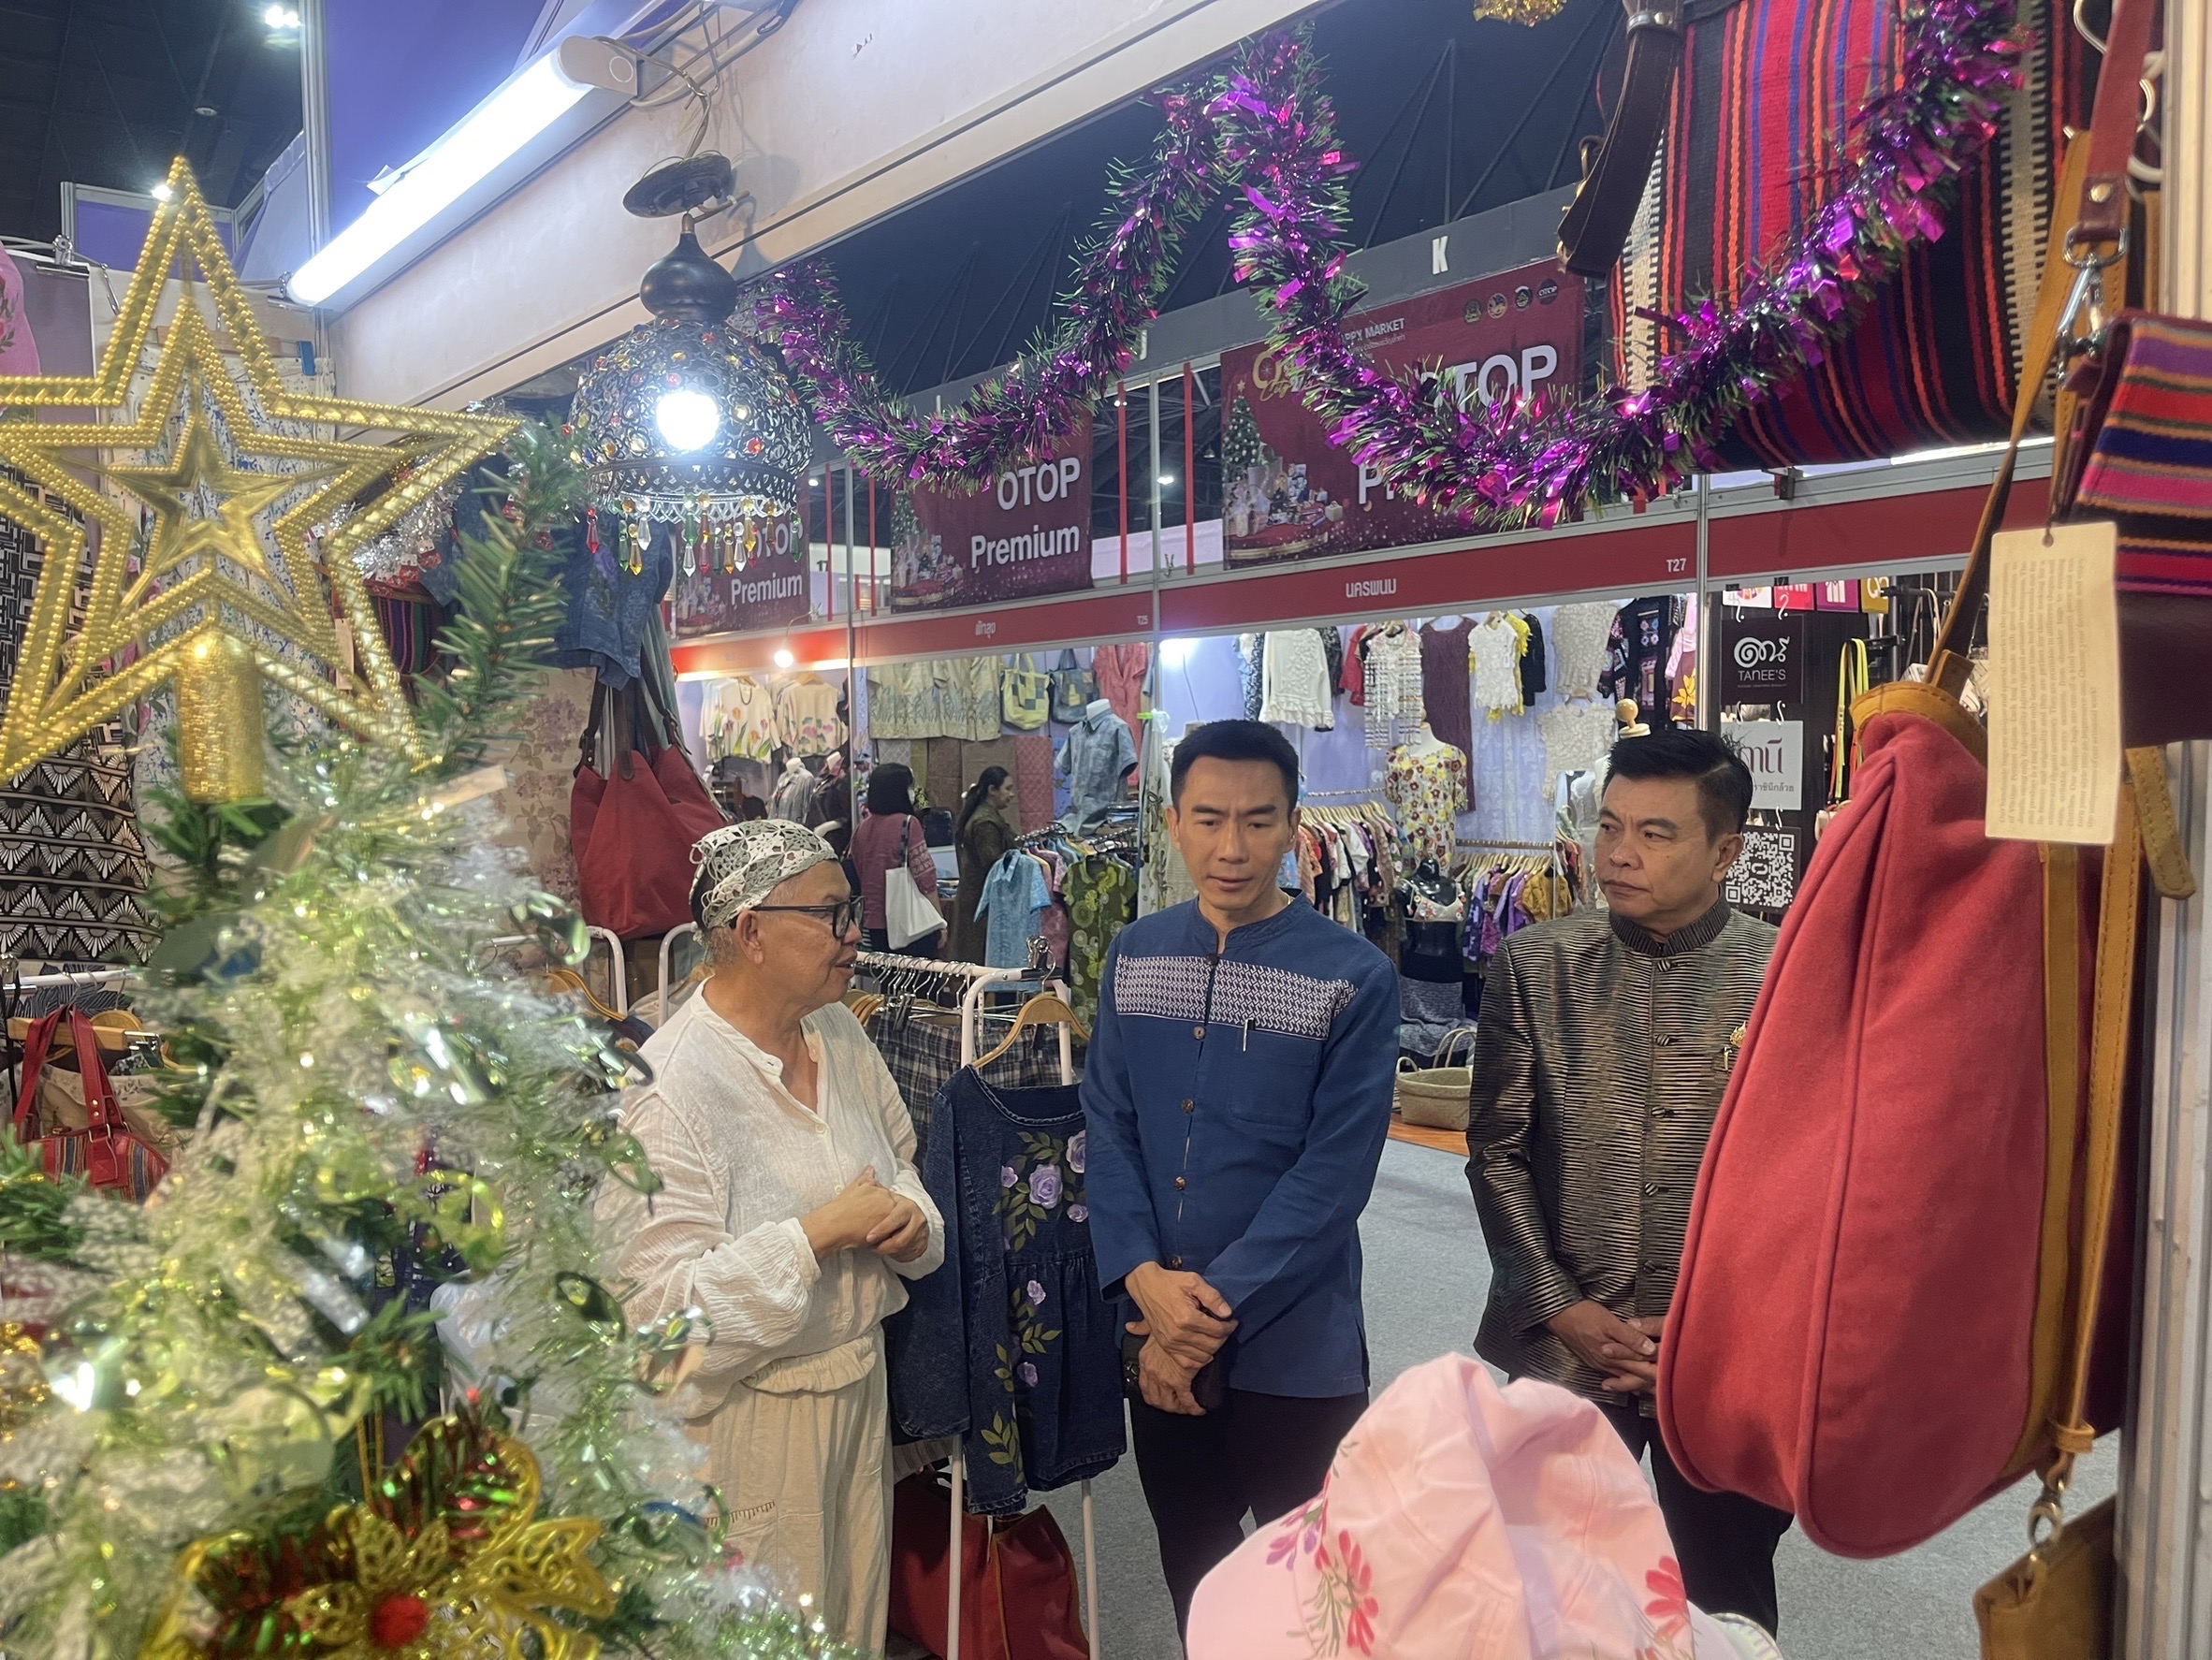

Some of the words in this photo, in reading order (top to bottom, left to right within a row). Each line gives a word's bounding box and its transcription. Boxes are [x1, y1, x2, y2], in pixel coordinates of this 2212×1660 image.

[1433, 235, 1448, 274] K
[1364, 317, 1405, 339] MARKET
[997, 457, 1081, 511] OTOP
[971, 524, 1080, 569] Premium
[1666, 558, 1687, 573] T27
[731, 572, 803, 605] Premium
[1346, 577, 1397, 598] นครพนม
